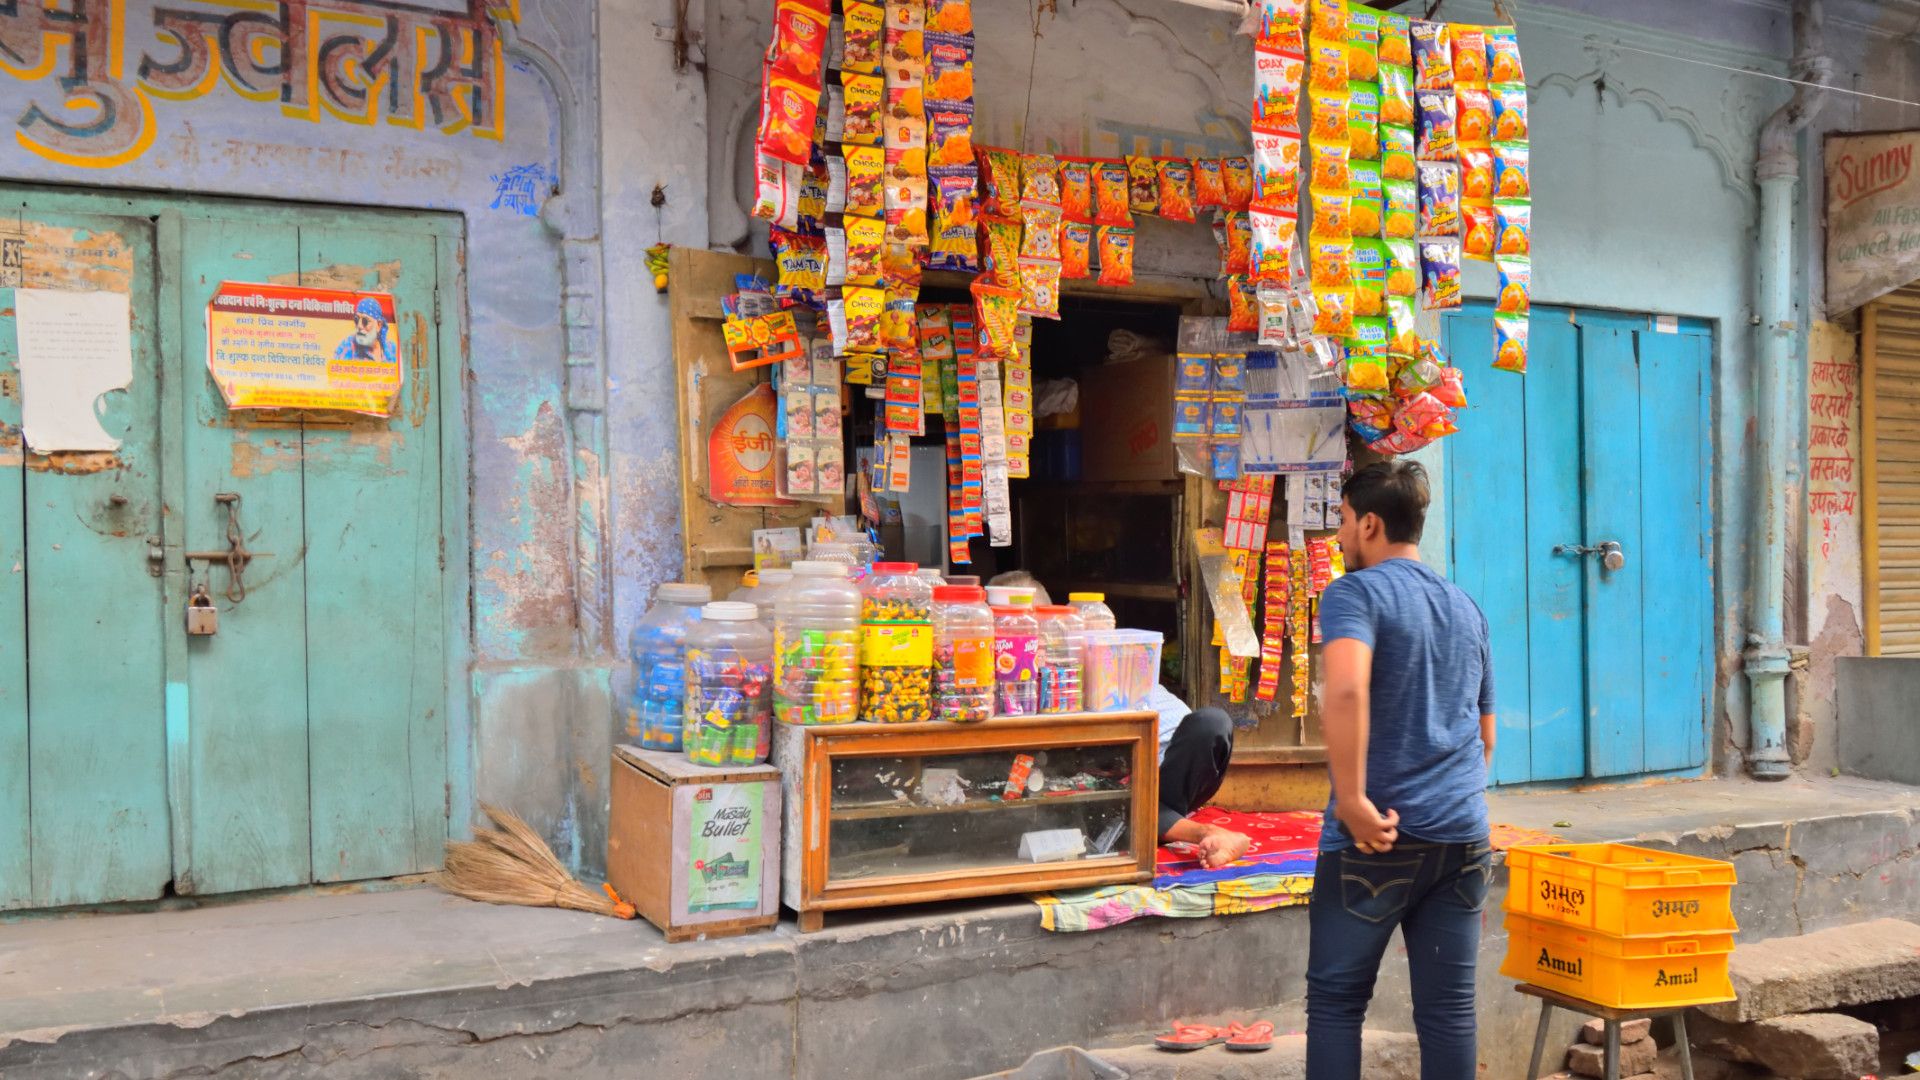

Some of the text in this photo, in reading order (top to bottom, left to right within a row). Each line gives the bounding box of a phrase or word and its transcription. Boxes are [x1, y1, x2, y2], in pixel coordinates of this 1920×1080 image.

[1257, 58, 1285, 70] CRAX
[1837, 144, 1912, 206] Sunny
[1872, 208, 1892, 227] All
[333, 300, 356, 314] शिविर
[235, 316, 254, 325] हमारे
[258, 317, 274, 326] प्रिय
[1811, 357, 1837, 388] हमारे
[1810, 391, 1854, 420] पर सभी
[1837, 421, 1851, 446] के
[1808, 490, 1858, 516] उपलध
[713, 807, 752, 820] Masala
[702, 819, 752, 838] Bullet
[1537, 947, 1583, 977] Amul
[1654, 967, 1699, 988] Amul
